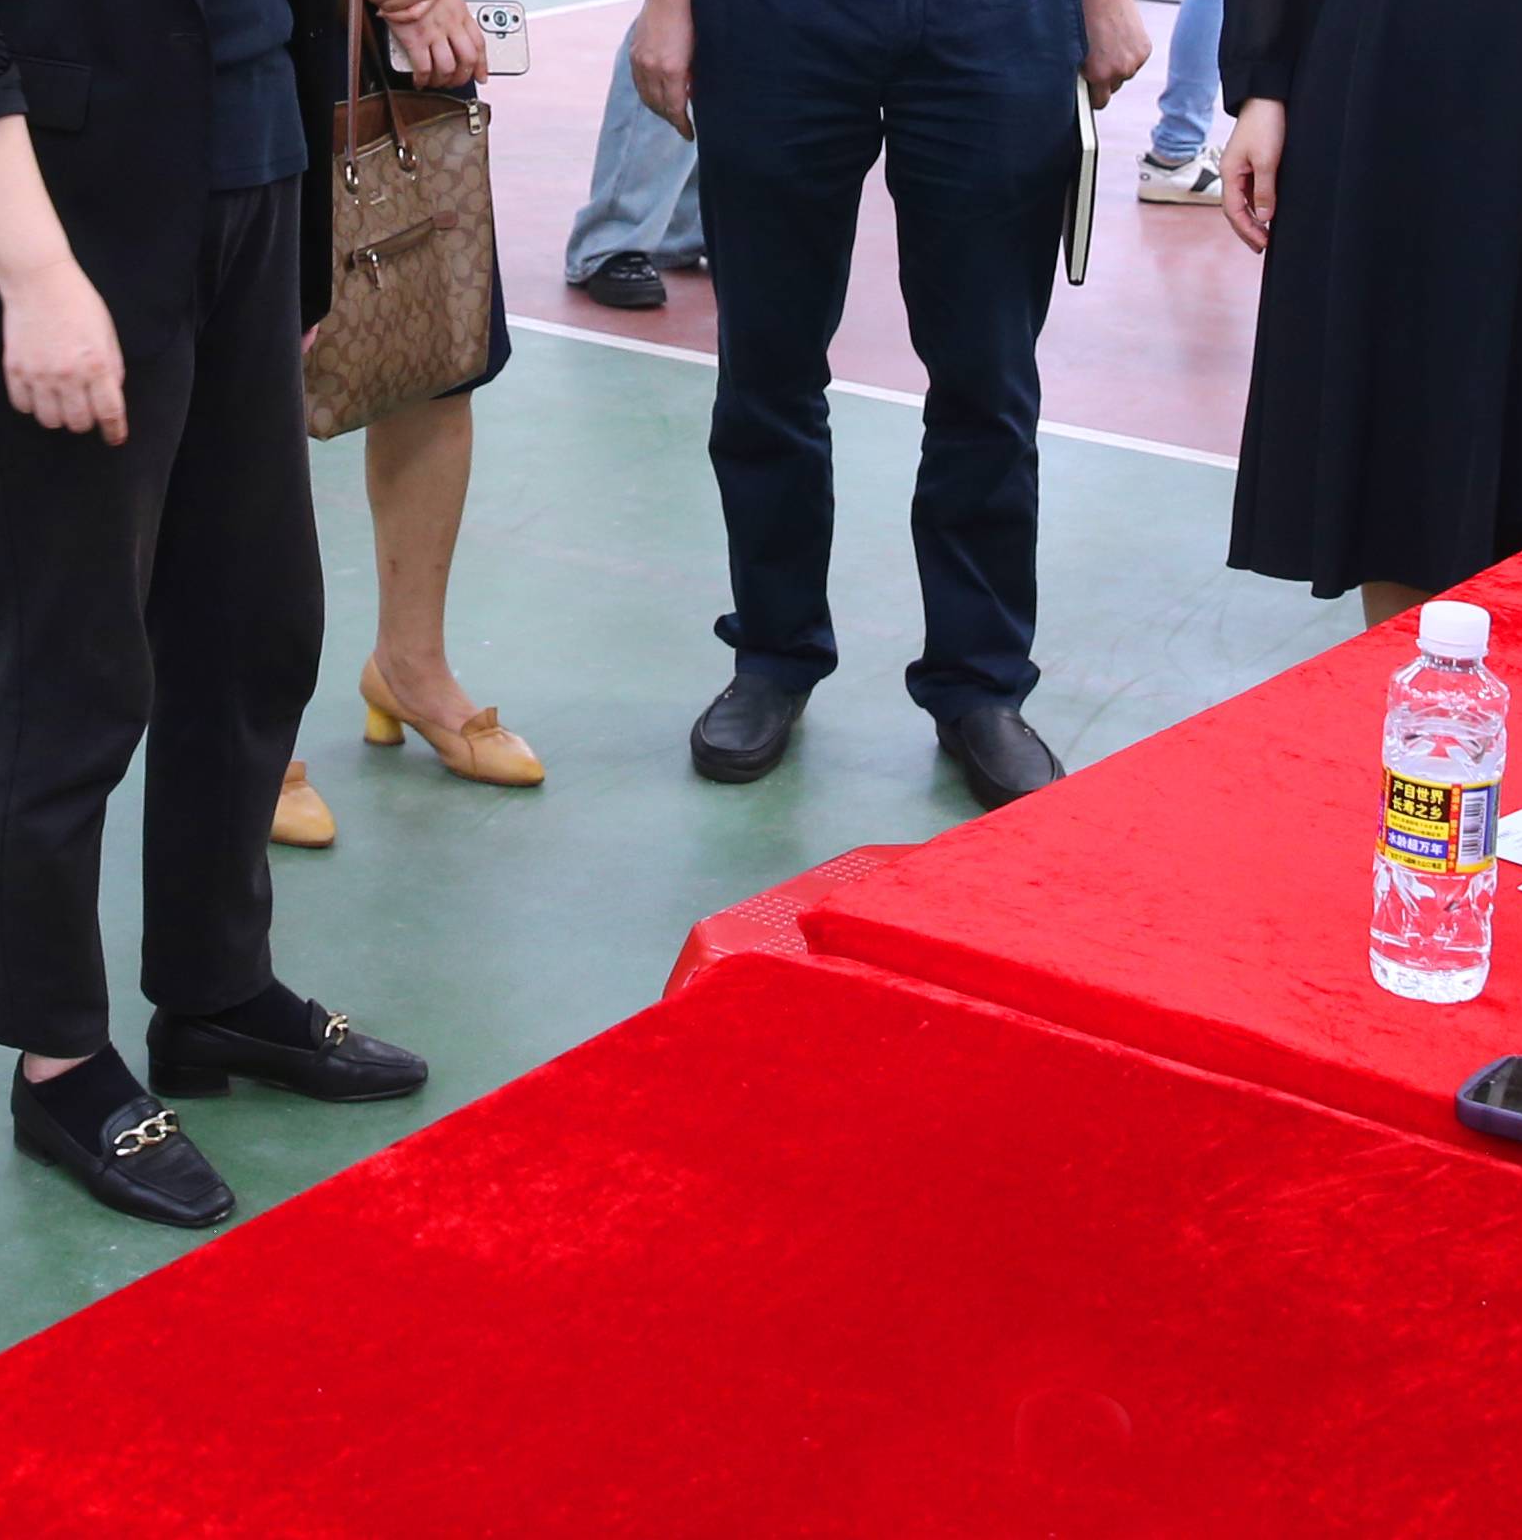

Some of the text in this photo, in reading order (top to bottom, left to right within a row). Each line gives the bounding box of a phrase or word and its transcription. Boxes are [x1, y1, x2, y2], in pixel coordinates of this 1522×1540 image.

[1393, 779, 1445, 805] 产自世界
[1391, 795, 1443, 820] 长寿之乡
